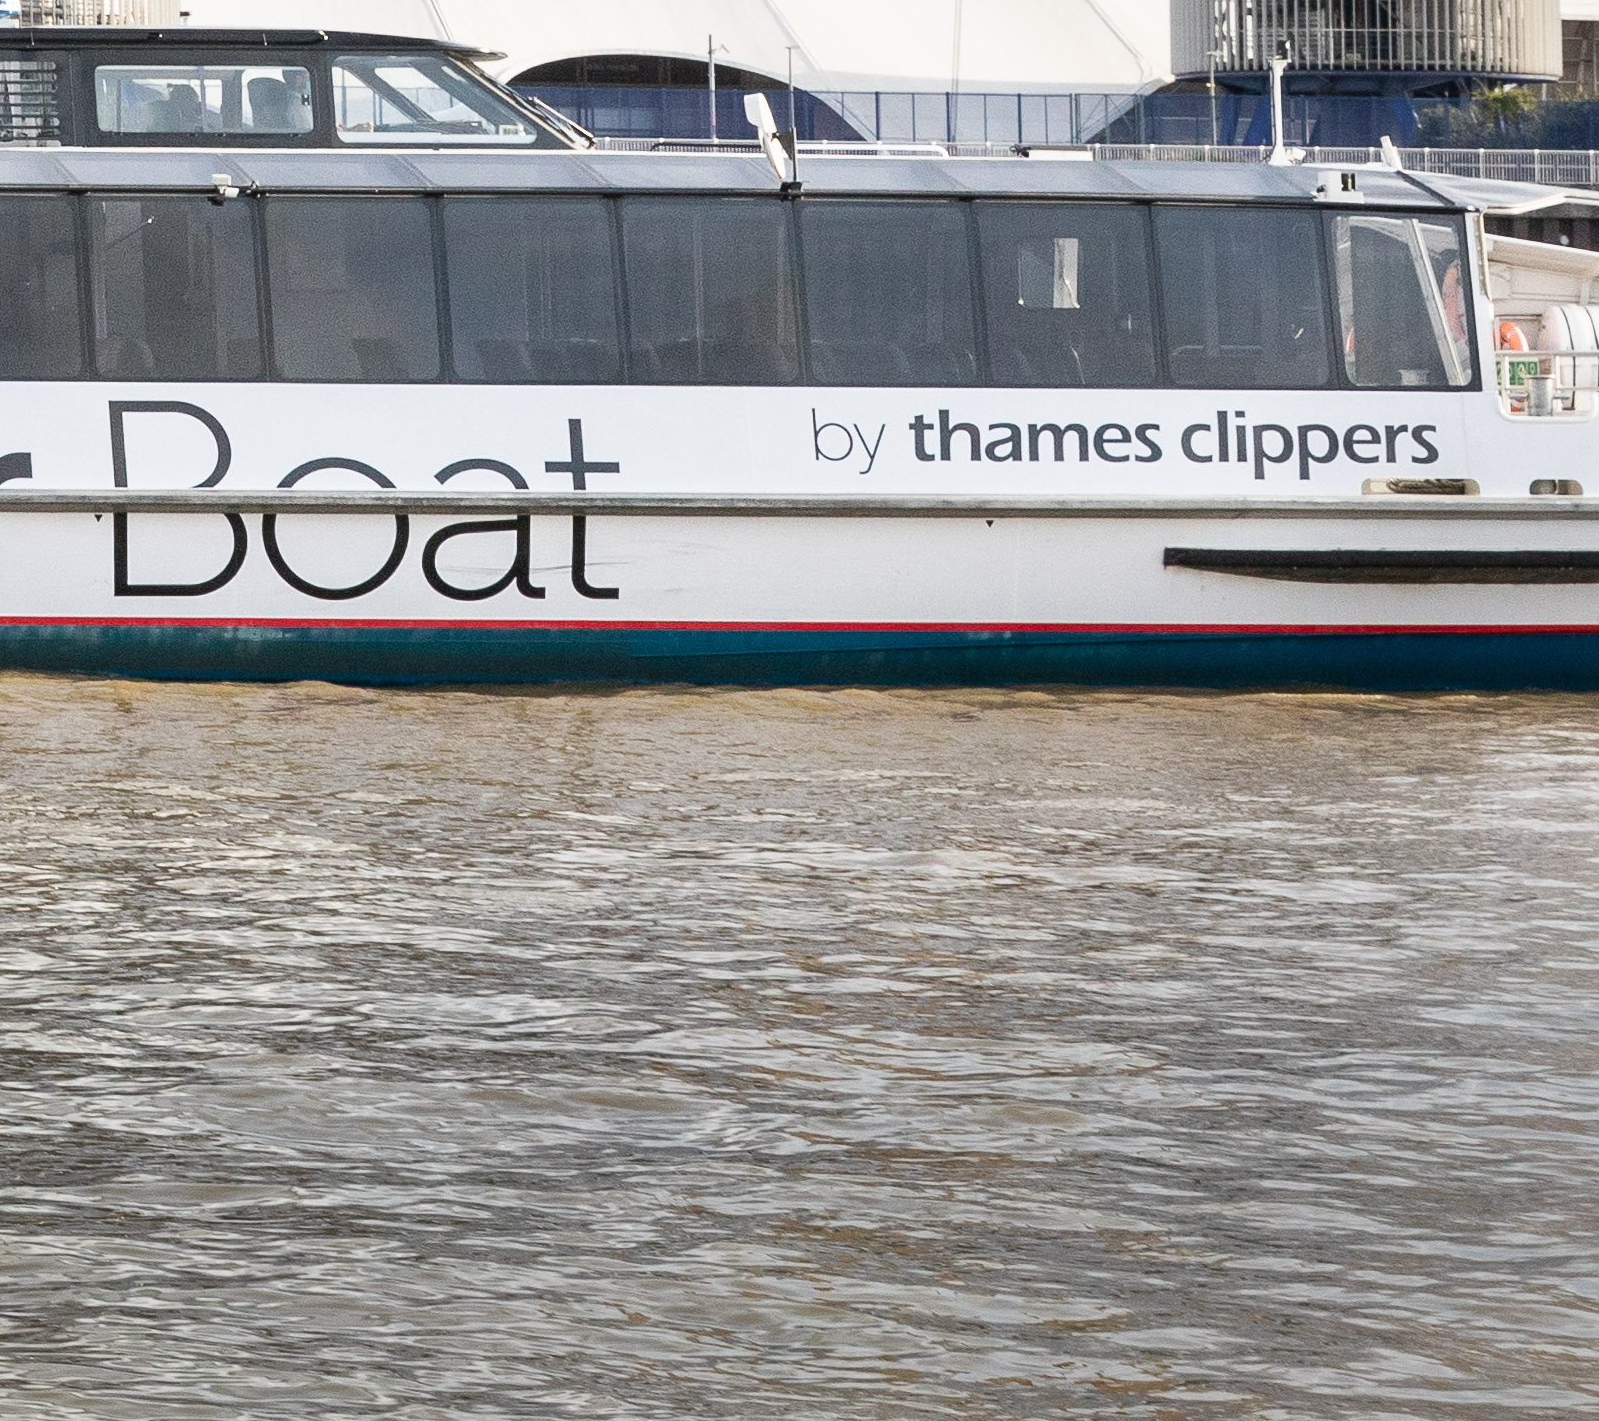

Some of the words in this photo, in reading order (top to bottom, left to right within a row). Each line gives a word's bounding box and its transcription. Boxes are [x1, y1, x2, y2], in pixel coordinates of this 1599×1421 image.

[108, 399, 620, 600] Boat
[811, 408, 886, 475] by
[909, 408, 1163, 464] thames
[1180, 410, 1440, 481] clippers
